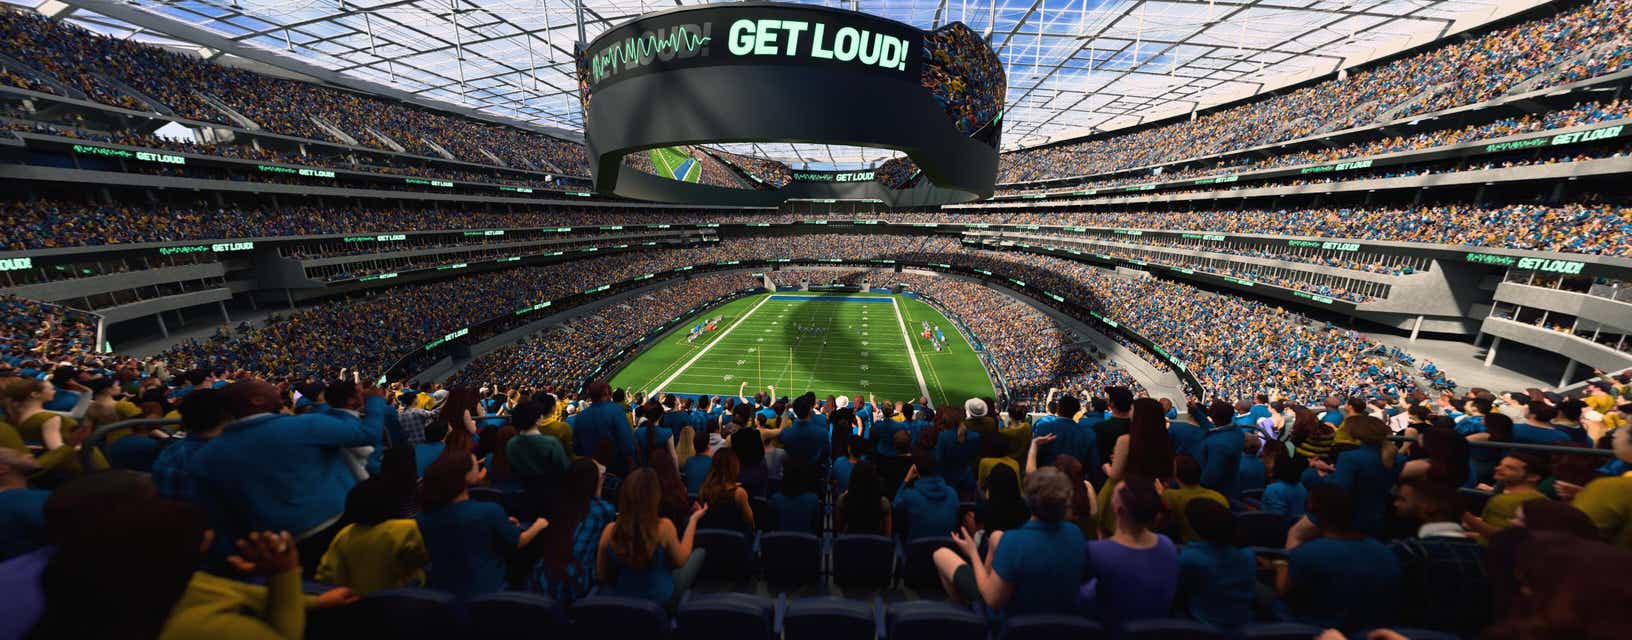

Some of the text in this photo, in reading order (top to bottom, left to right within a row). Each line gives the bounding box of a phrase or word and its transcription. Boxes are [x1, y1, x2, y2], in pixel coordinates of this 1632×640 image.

[728, 19, 909, 71] GET LOUD!
[593, 22, 712, 83] ET LOUD!
[1552, 126, 1624, 145] GET LOUD!
[136, 152, 185, 164] GET LOUD!
[1335, 162, 1352, 170] GET
[836, 172, 875, 182] GET LOUD!
[212, 242, 253, 252] GET LOUD!
[1322, 242, 1339, 250] GET
[0, 258, 32, 270] OUD!
[1518, 257, 1585, 274] GET LOUD!
